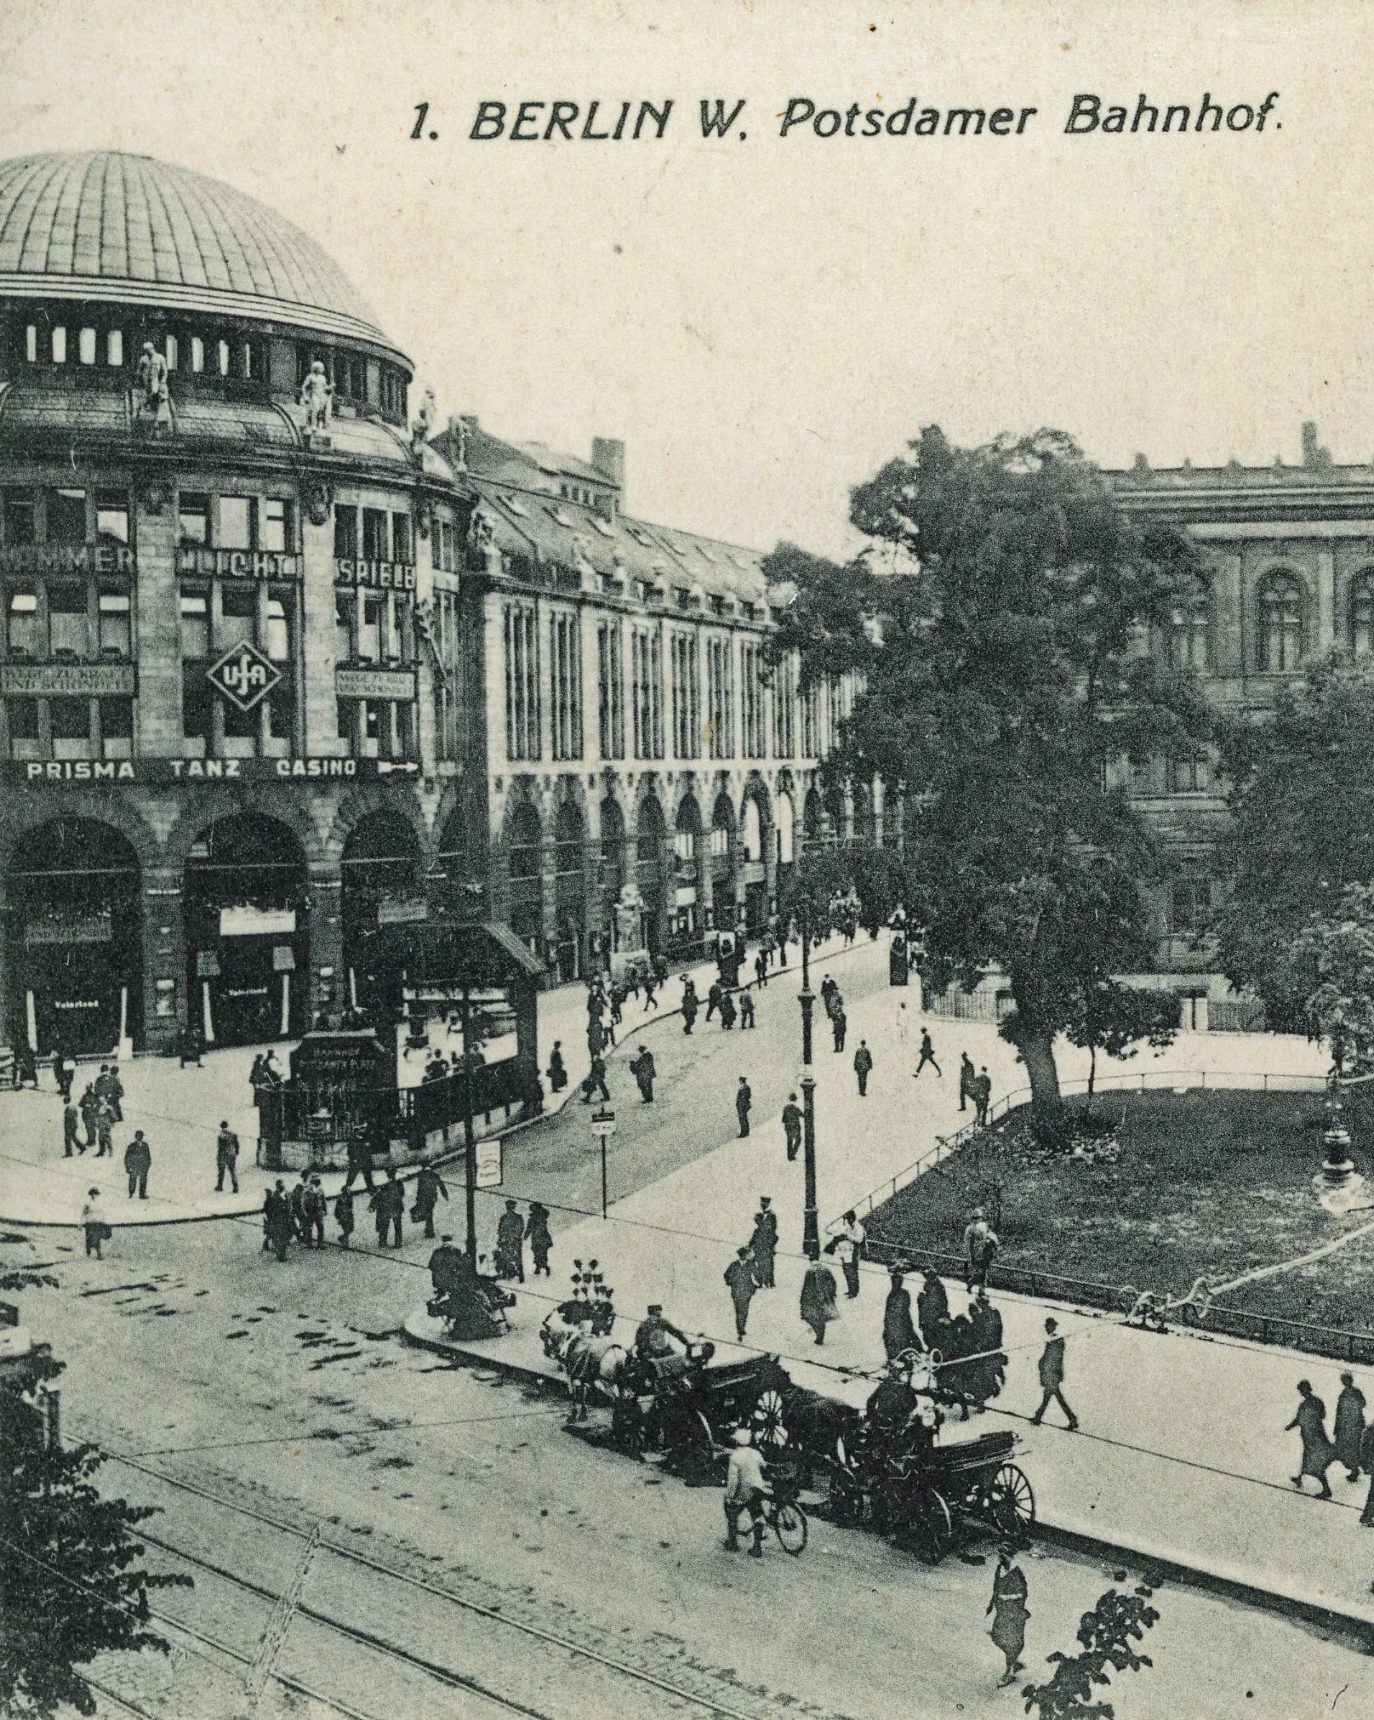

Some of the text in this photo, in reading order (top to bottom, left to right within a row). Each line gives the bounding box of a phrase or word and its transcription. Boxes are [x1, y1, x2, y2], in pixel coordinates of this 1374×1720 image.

[196, 551, 290, 579] LICHT
[339, 559, 416, 589] SPIELE
[27, 759, 356, 780] PRISMA TANZ CASINO
